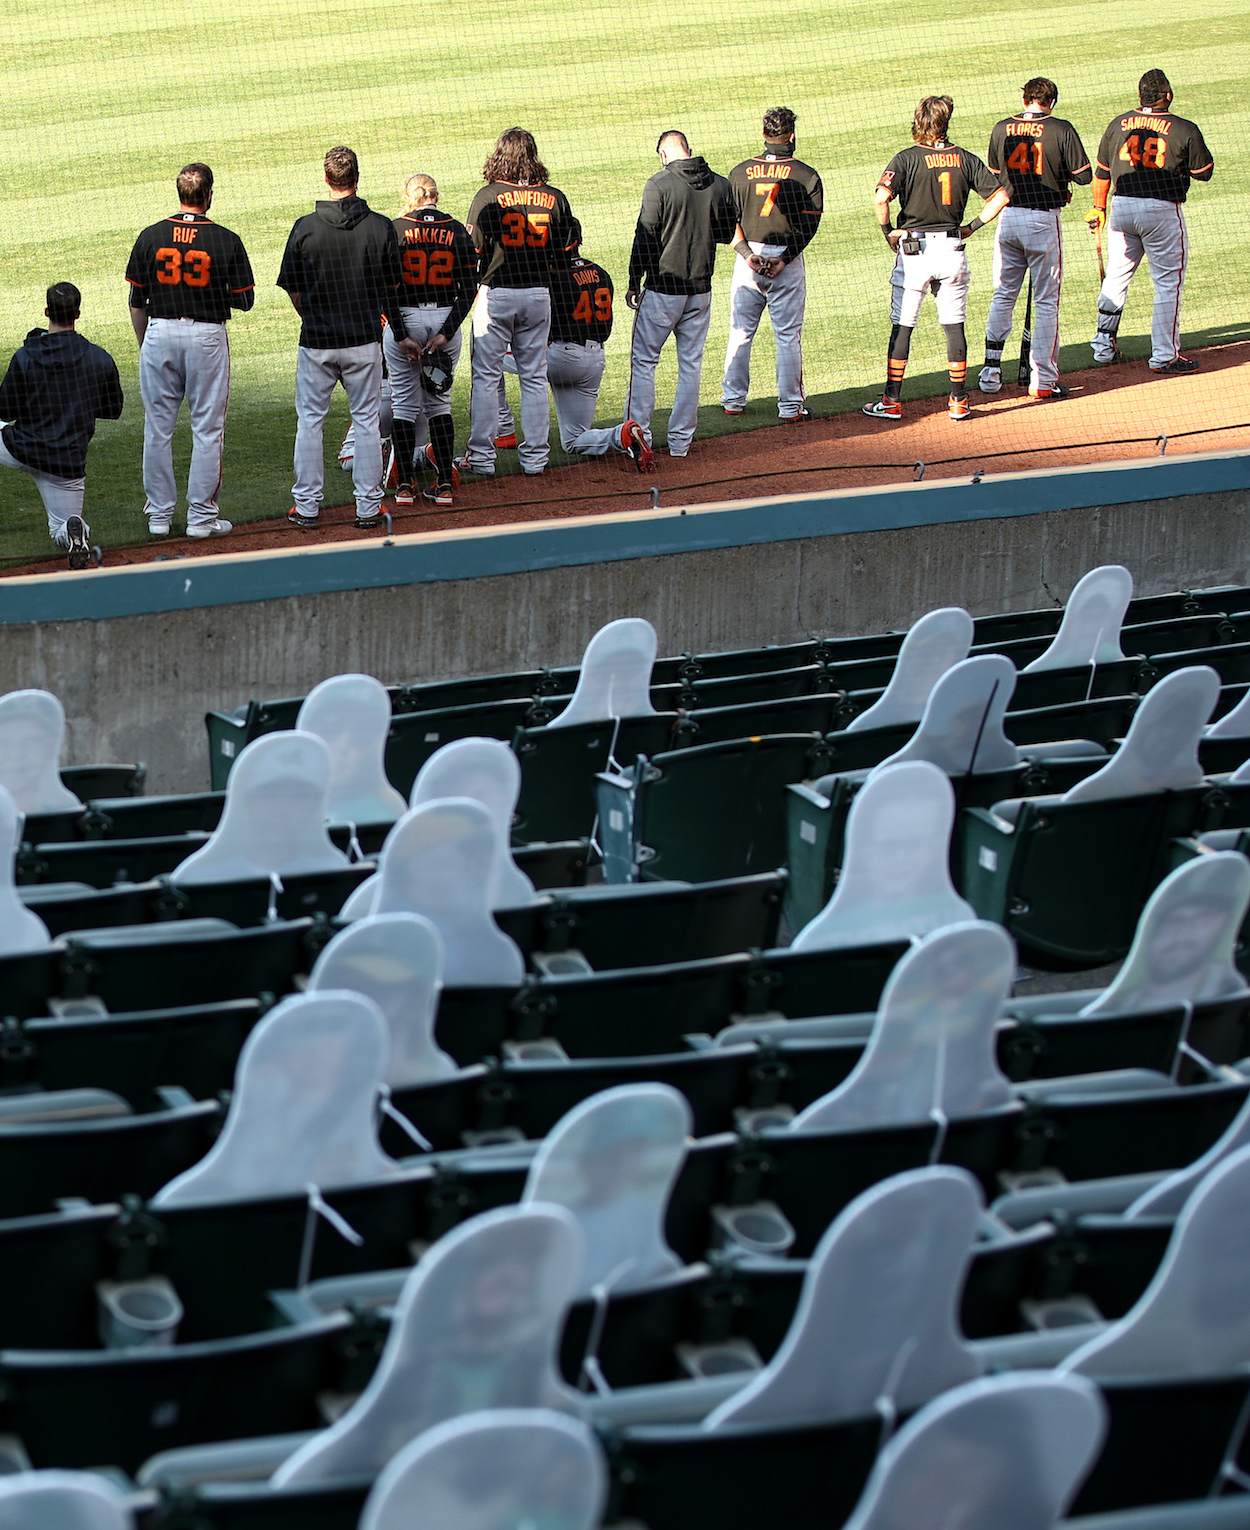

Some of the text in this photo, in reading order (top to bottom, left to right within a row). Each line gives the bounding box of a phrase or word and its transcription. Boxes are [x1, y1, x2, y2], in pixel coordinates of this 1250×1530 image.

[1006, 121, 1045, 137] FLORES
[1120, 115, 1172, 135] SANDOVAL
[924, 153, 961, 169] DUBON
[1008, 141, 1043, 175] 41
[1118, 133, 1168, 168] 48
[745, 162, 792, 180] SOLANO
[496, 190, 557, 210] CRAWFORD
[755, 182, 779, 217] 7
[937, 171, 952, 205] 1
[173, 226, 198, 244] RUF
[404, 227, 454, 246] NAKKEN
[502, 212, 551, 248] 35
[156, 247, 211, 286] 33
[404, 250, 454, 286] 92
[573, 270, 600, 285] DAVIS
[573, 288, 611, 322] 49
